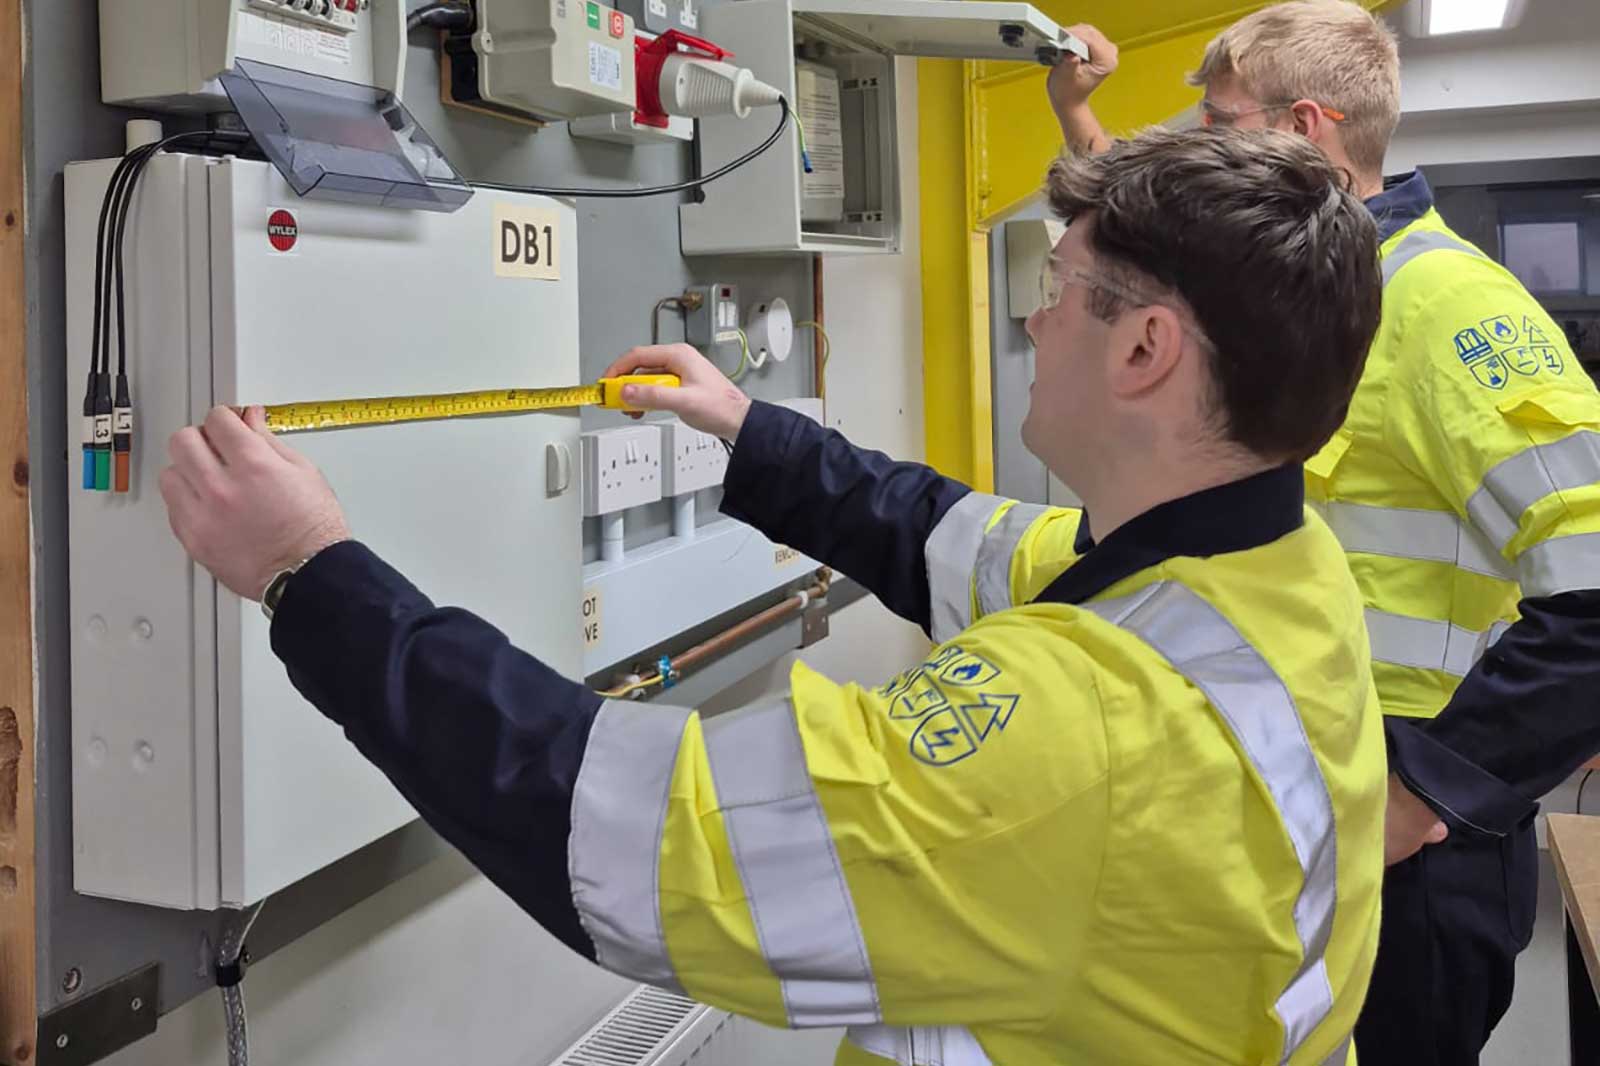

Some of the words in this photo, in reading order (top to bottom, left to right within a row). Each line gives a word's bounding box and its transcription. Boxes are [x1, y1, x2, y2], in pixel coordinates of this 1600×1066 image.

[269, 224, 297, 237] WYLEX
[501, 220, 552, 266] DB1
[95, 418, 109, 438] L3
[118, 412, 131, 430] L1
